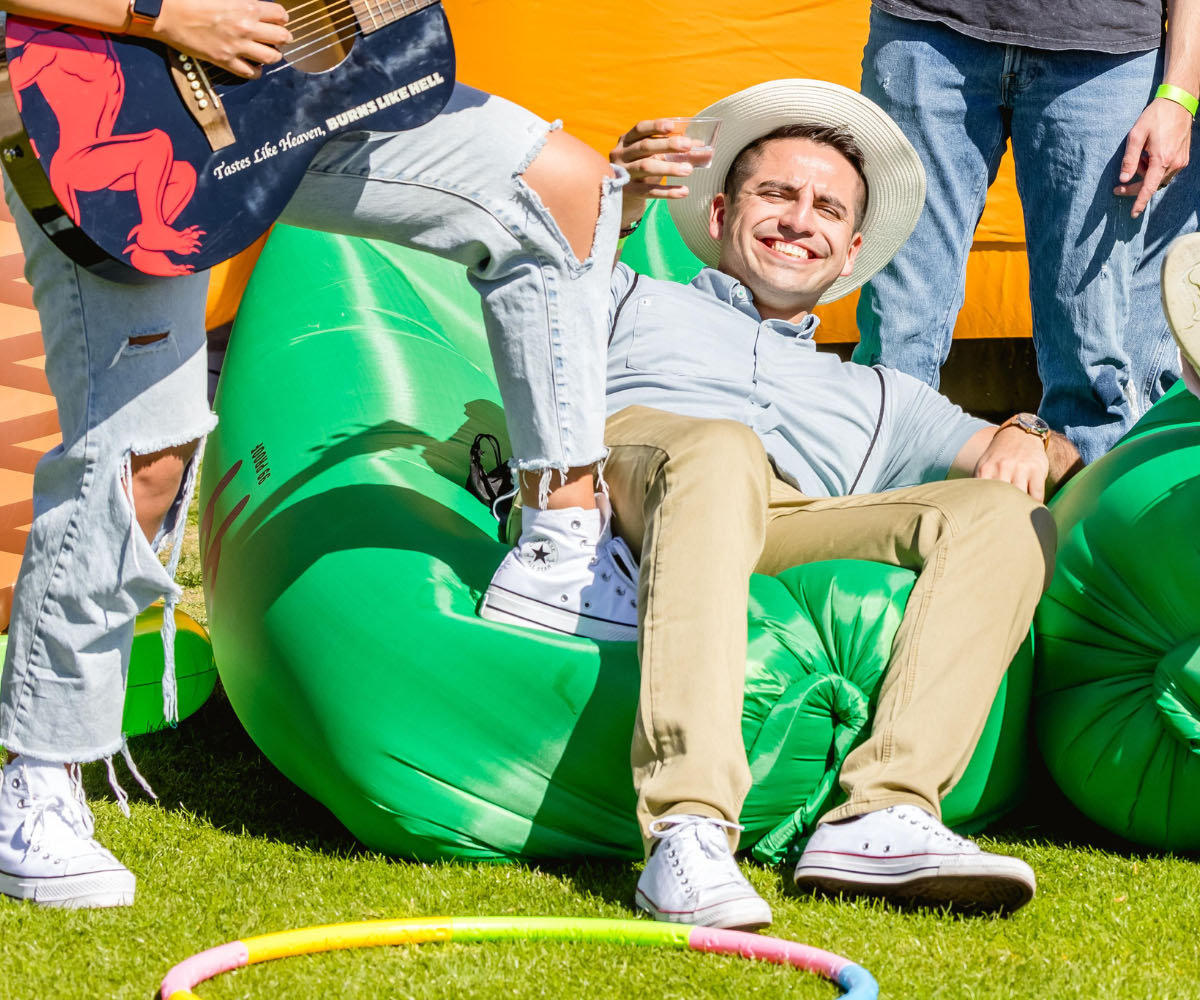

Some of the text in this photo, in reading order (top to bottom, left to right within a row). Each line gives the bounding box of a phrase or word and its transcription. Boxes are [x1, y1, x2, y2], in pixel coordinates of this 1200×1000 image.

[213, 71, 445, 180] Tastes Like Heaven, BURNS LIKE HELL
